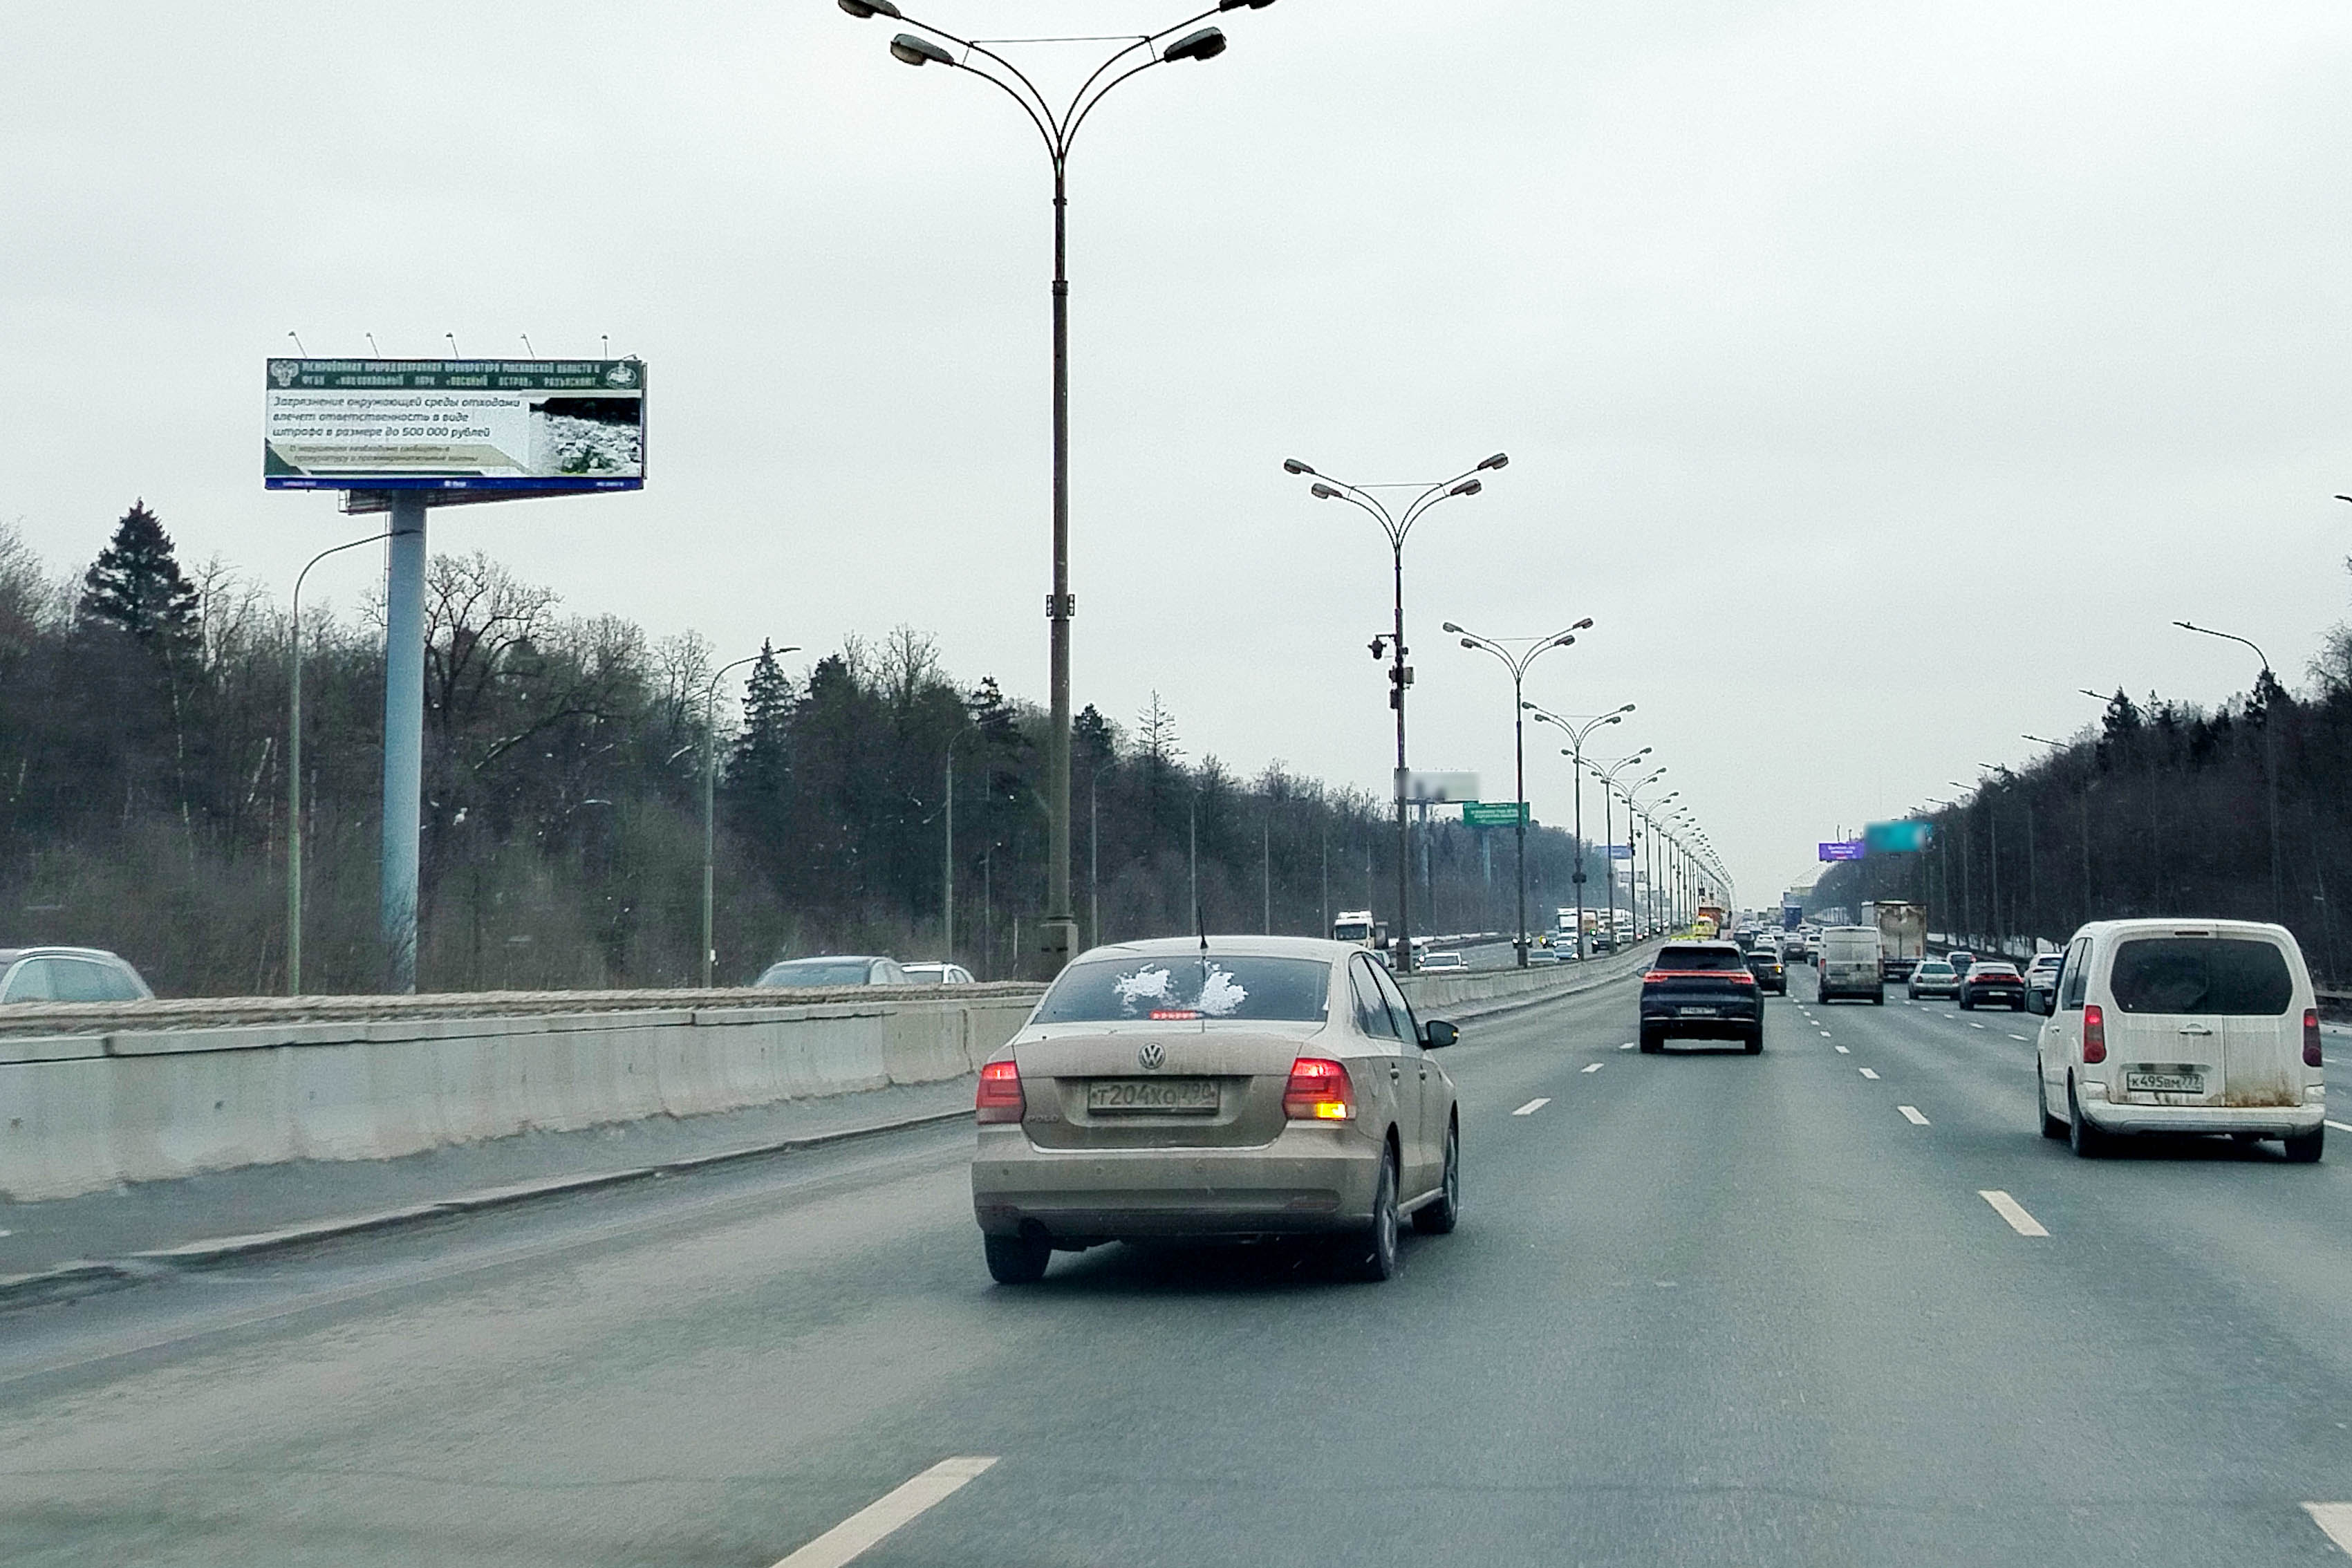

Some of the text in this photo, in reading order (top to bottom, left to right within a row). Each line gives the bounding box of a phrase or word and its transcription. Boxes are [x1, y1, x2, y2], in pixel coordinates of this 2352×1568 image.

[274, 396, 520, 409] Загрязнение окружающей среды отходами
[319, 413, 430, 422] ответственность
[442, 412, 469, 422] виде
[272, 427, 324, 438] штрафа
[335, 429, 382, 438] размере
[385, 427, 400, 436] до
[402, 427, 424, 437] 500
[427, 427, 449, 436] 000
[451, 427, 490, 439] рублей
